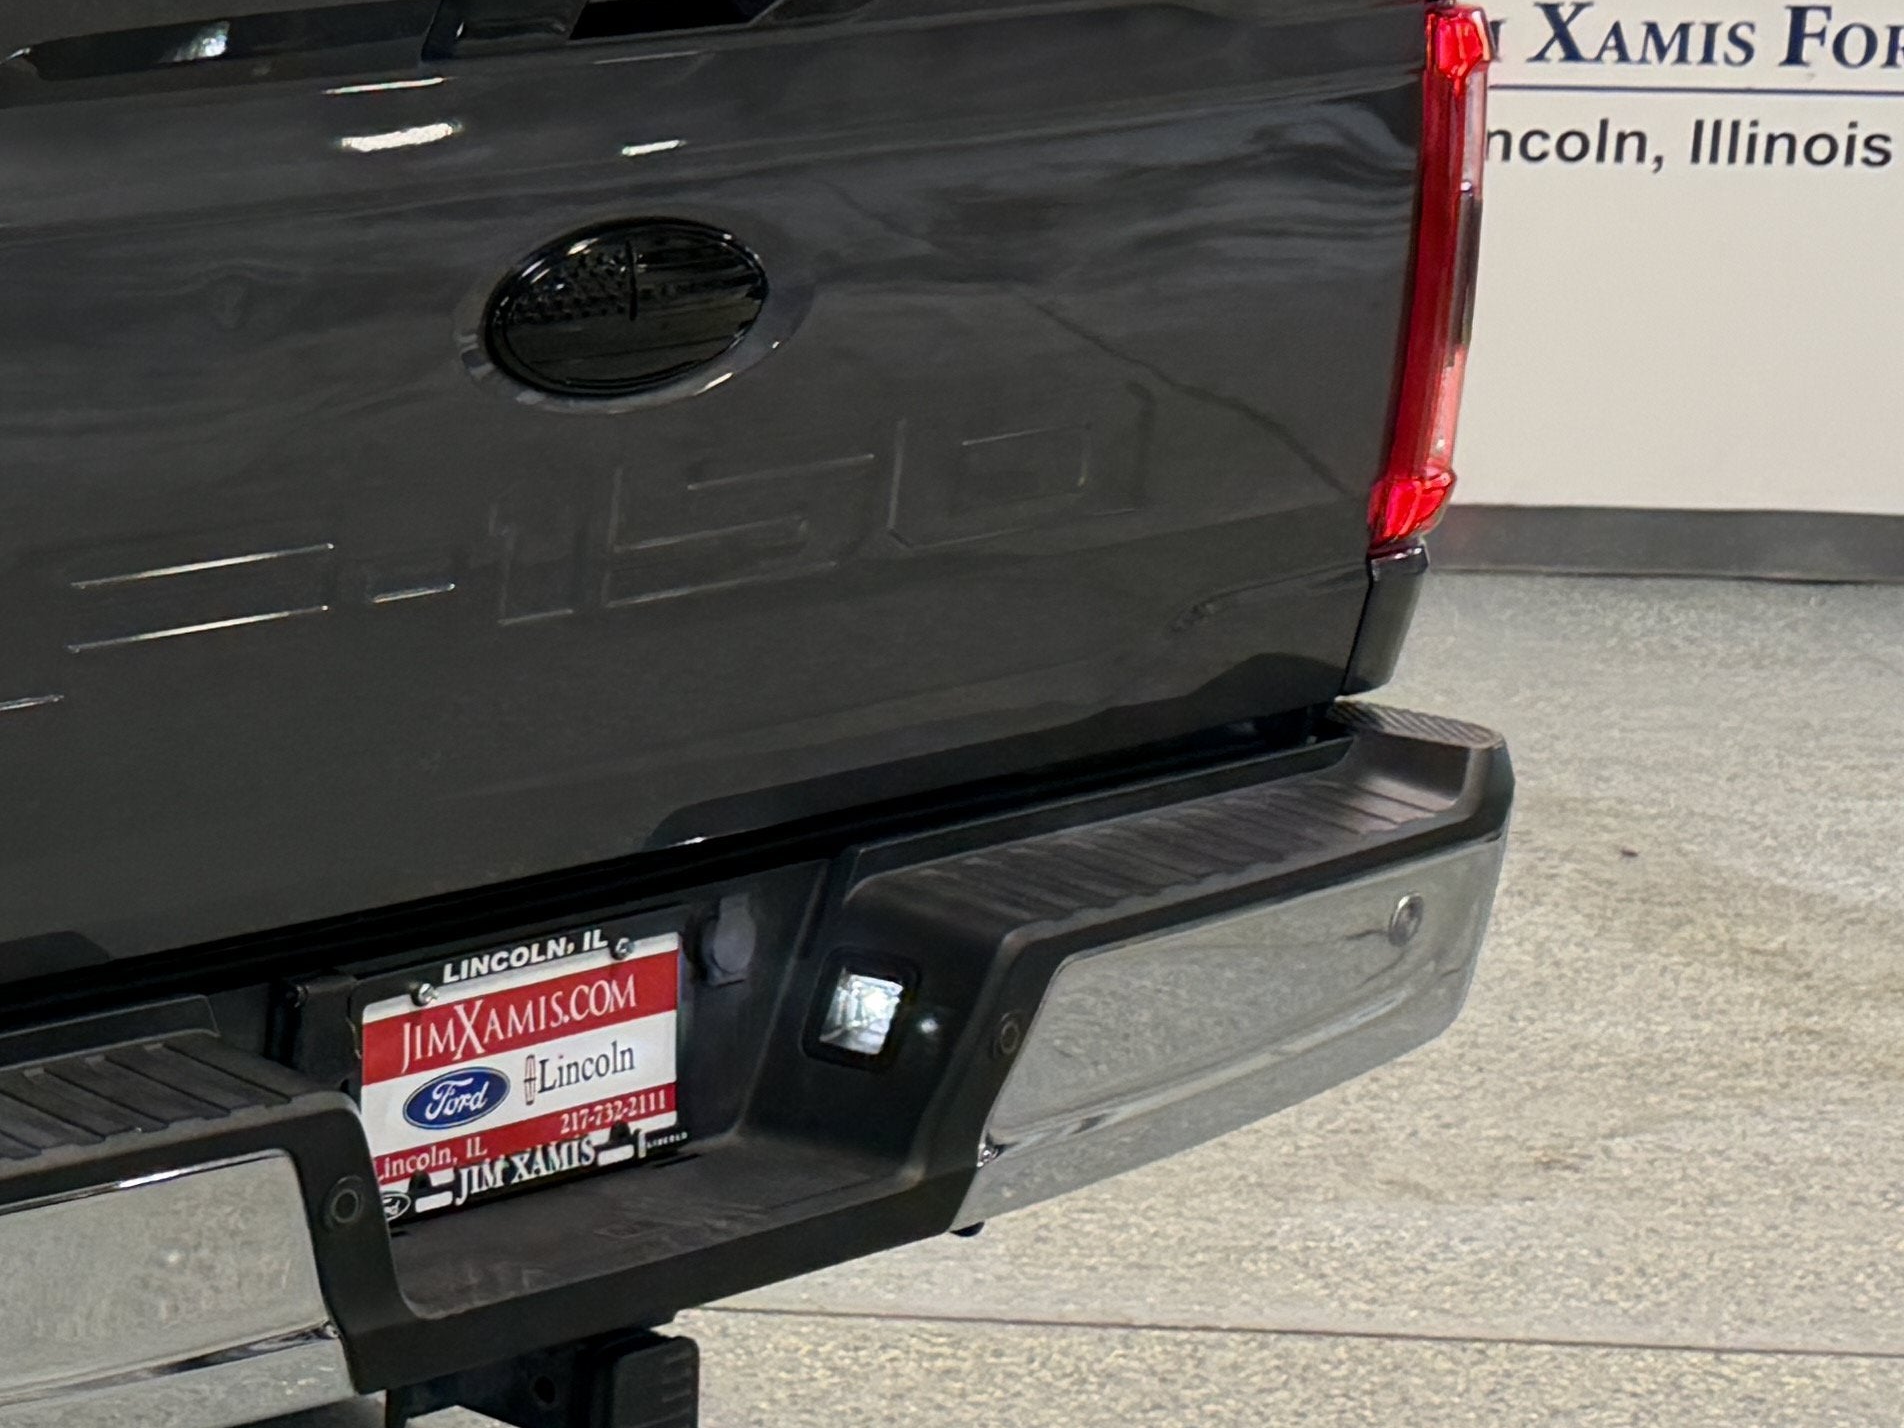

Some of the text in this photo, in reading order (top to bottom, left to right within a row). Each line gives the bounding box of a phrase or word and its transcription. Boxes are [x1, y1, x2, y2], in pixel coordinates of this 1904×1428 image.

[1525, 0, 1757, 69] XAMIS
[1486, 116, 1893, 175] ncoln, Illinois
[442, 928, 610, 984] LINCOLN, IL
[424, 1039, 635, 1122] Ford Lincoln
[559, 1089, 667, 1135] 217-732-2111
[455, 1139, 596, 1206] JIM XAMIS
[465, 1136, 488, 1161] IL
